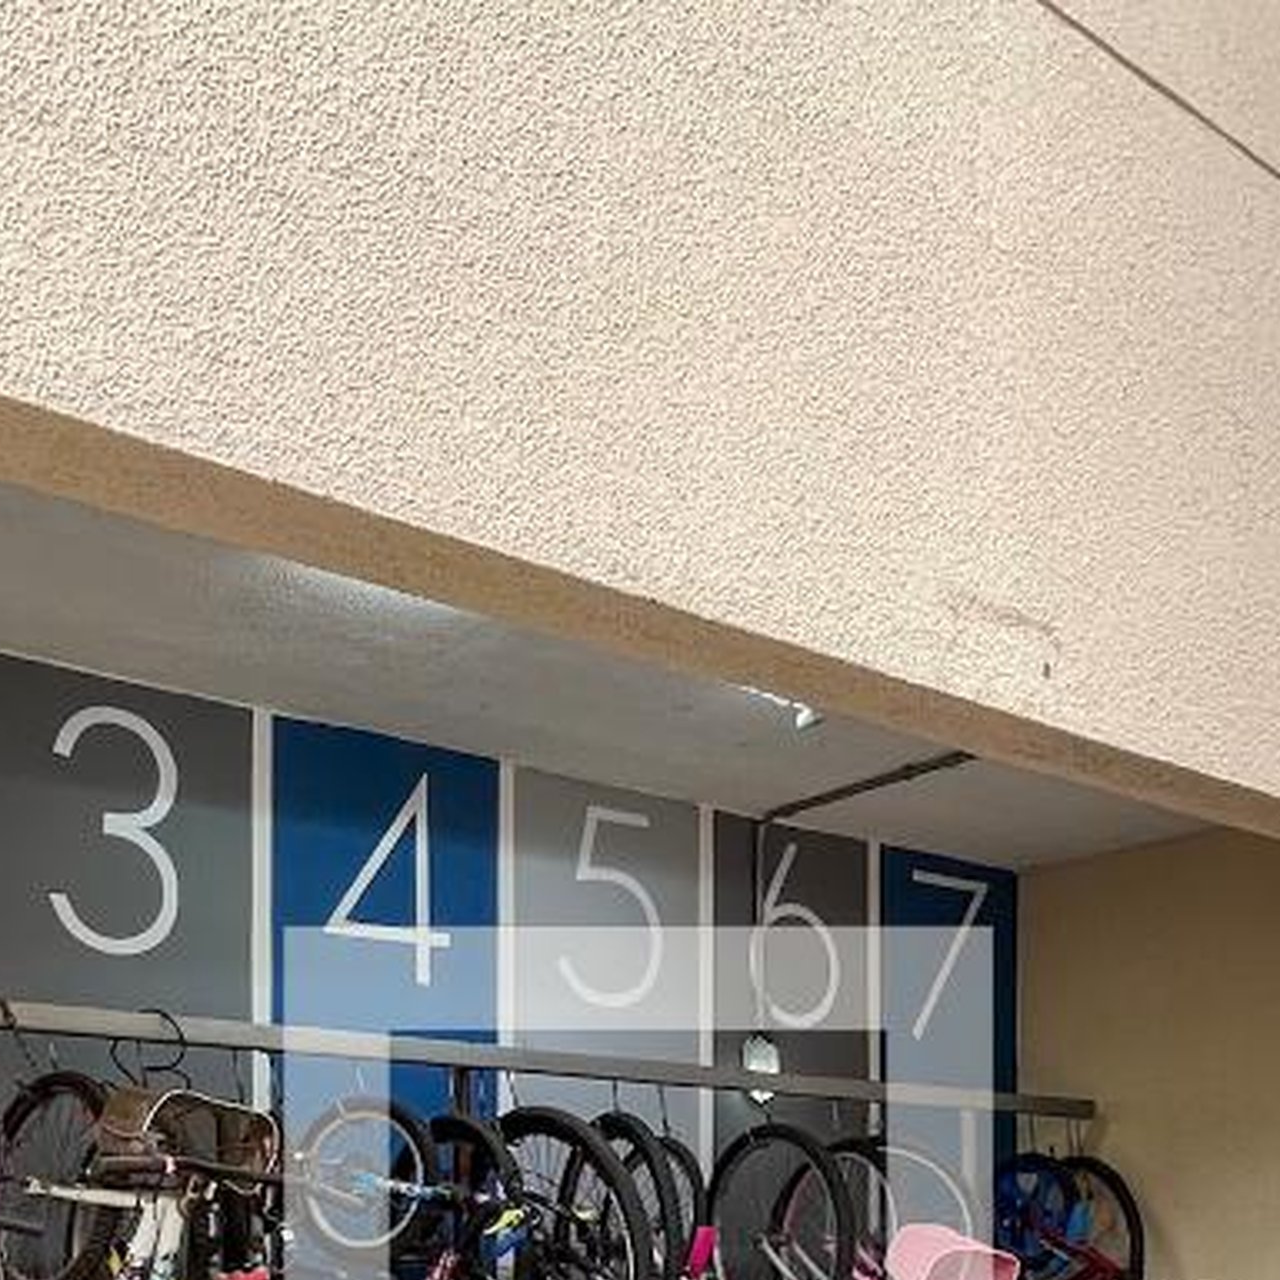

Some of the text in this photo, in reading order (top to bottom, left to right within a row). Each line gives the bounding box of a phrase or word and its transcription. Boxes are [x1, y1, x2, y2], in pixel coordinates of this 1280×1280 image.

[47, 705, 179, 956] 3
[322, 771, 451, 987] 4
[557, 805, 664, 1008] 5
[751, 843, 839, 1030] 6
[912, 868, 988, 1040] 7
